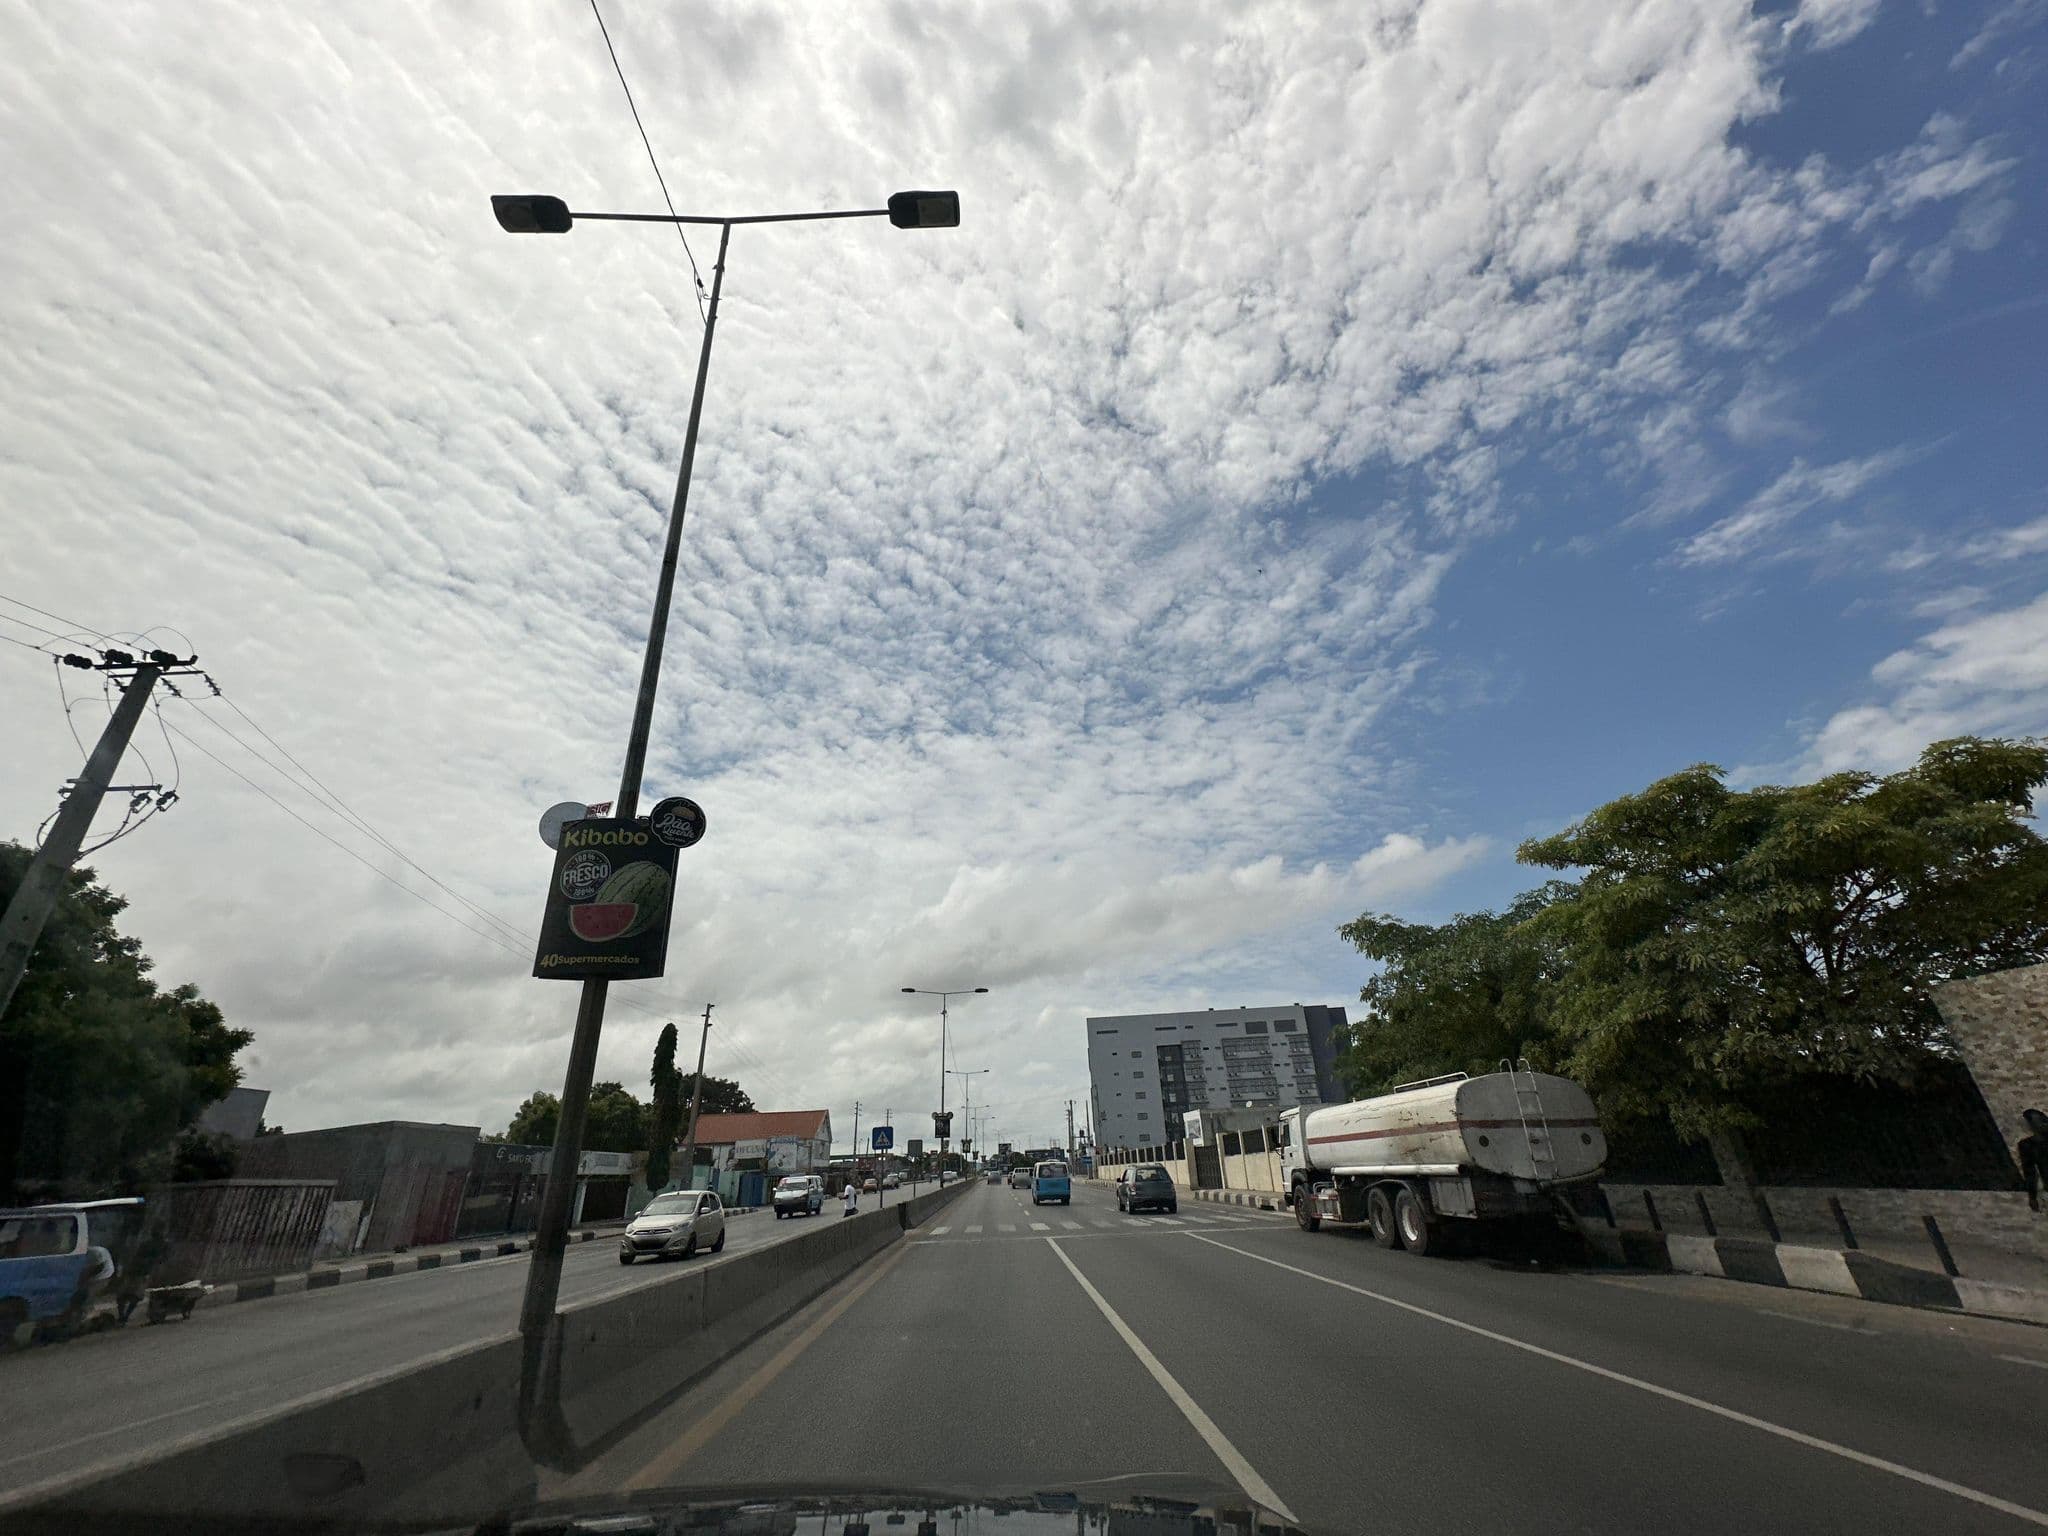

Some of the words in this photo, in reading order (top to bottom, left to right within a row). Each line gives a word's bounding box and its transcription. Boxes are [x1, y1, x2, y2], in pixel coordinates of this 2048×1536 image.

[655, 812, 691, 831] Pão
[564, 828, 649, 848] Kibabo
[563, 864, 609, 886] FRESCO
[540, 953, 558, 968] 40
[557, 954, 640, 966] Supermercados
